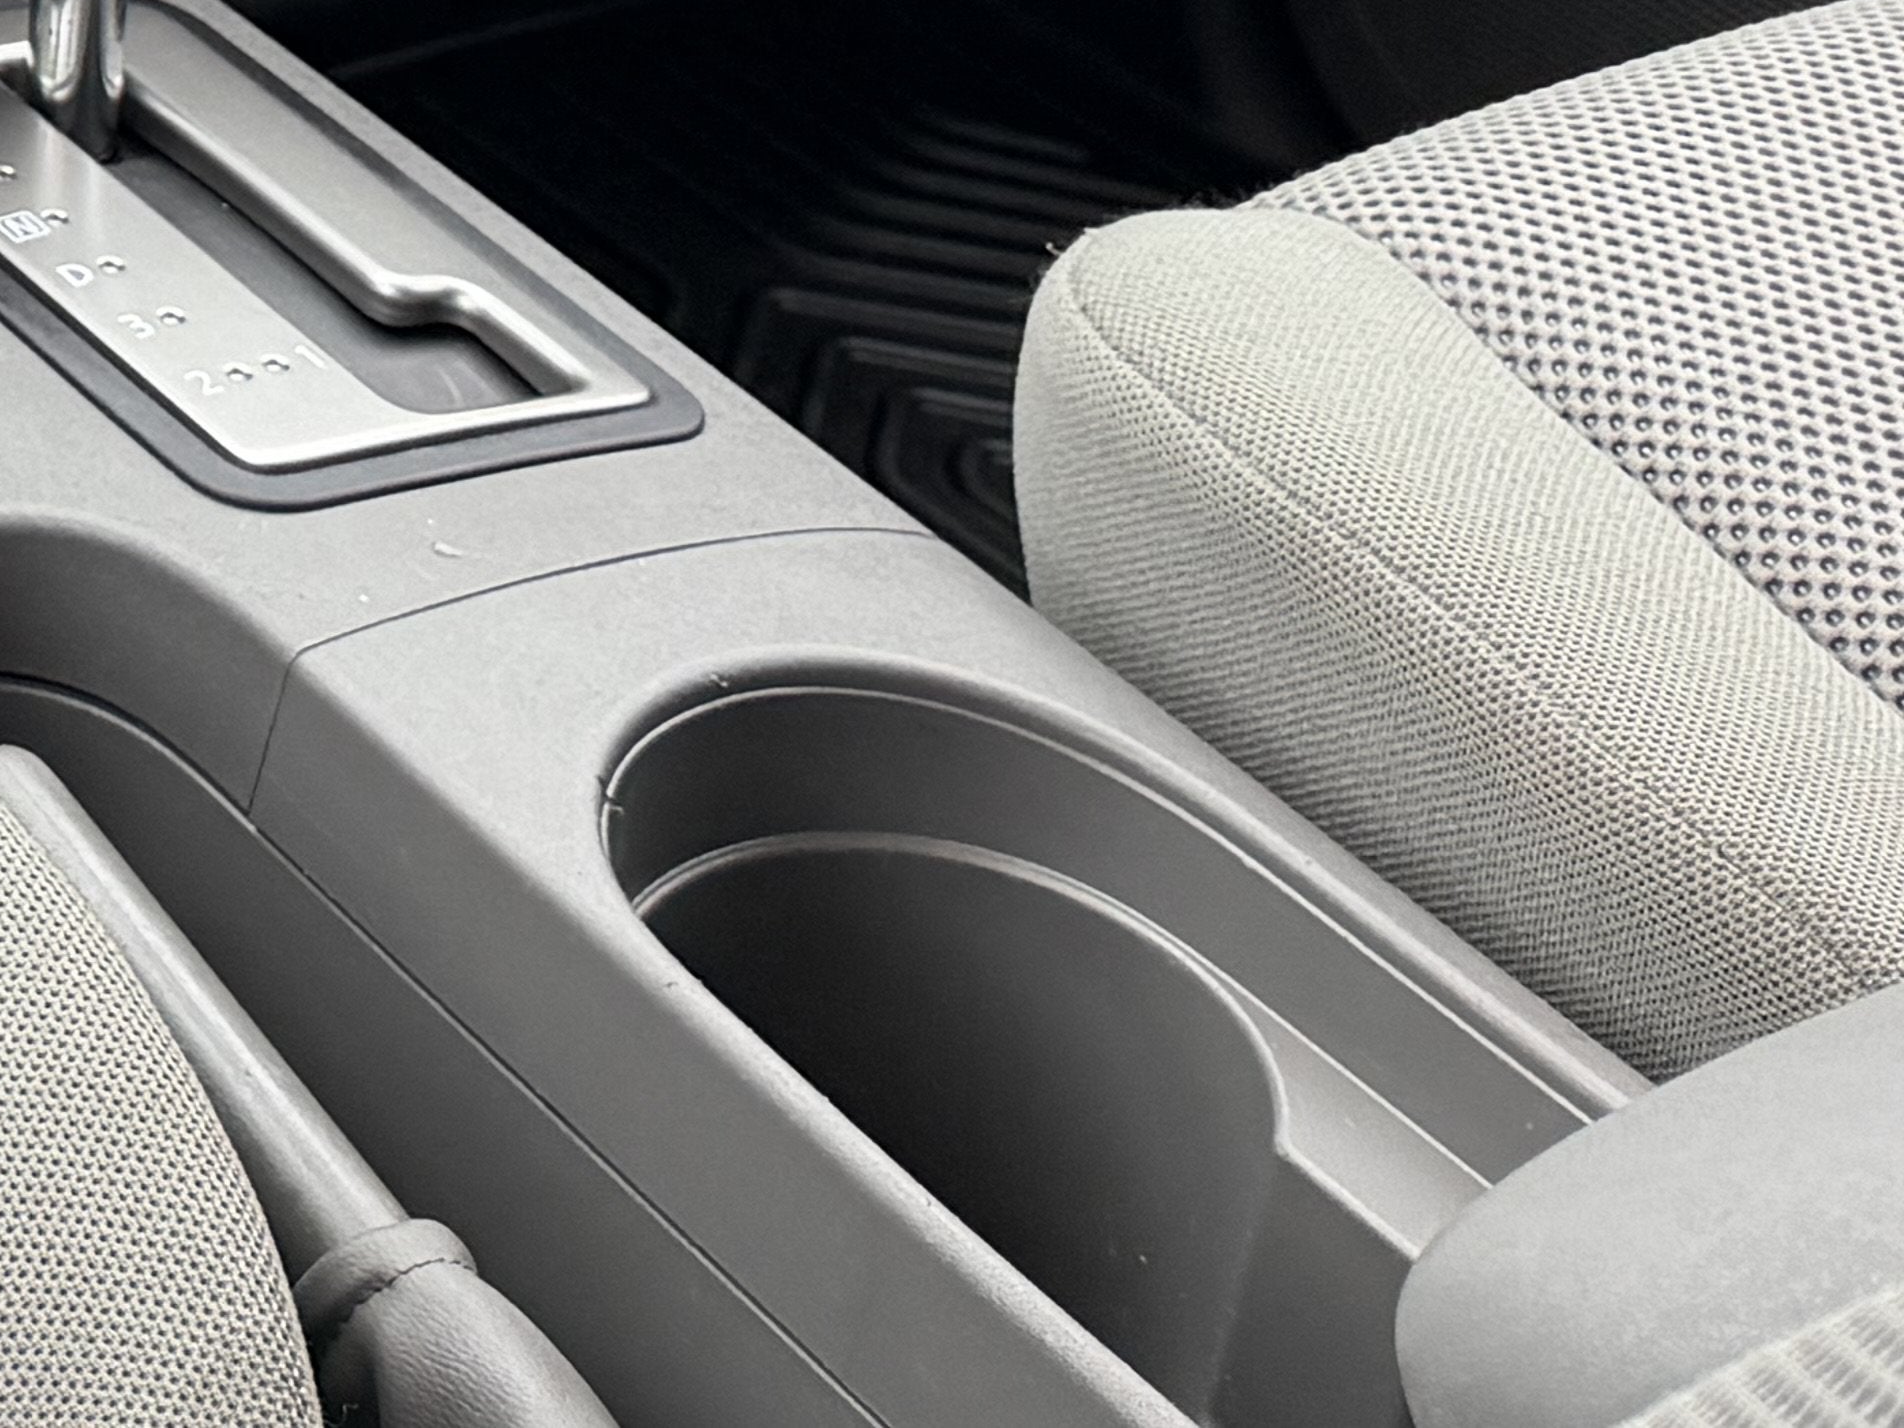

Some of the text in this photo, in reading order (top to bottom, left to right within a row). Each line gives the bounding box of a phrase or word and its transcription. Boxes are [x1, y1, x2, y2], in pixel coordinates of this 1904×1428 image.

[55, 262, 95, 289] D
[117, 312, 156, 339] 3
[183, 369, 226, 396] 2
